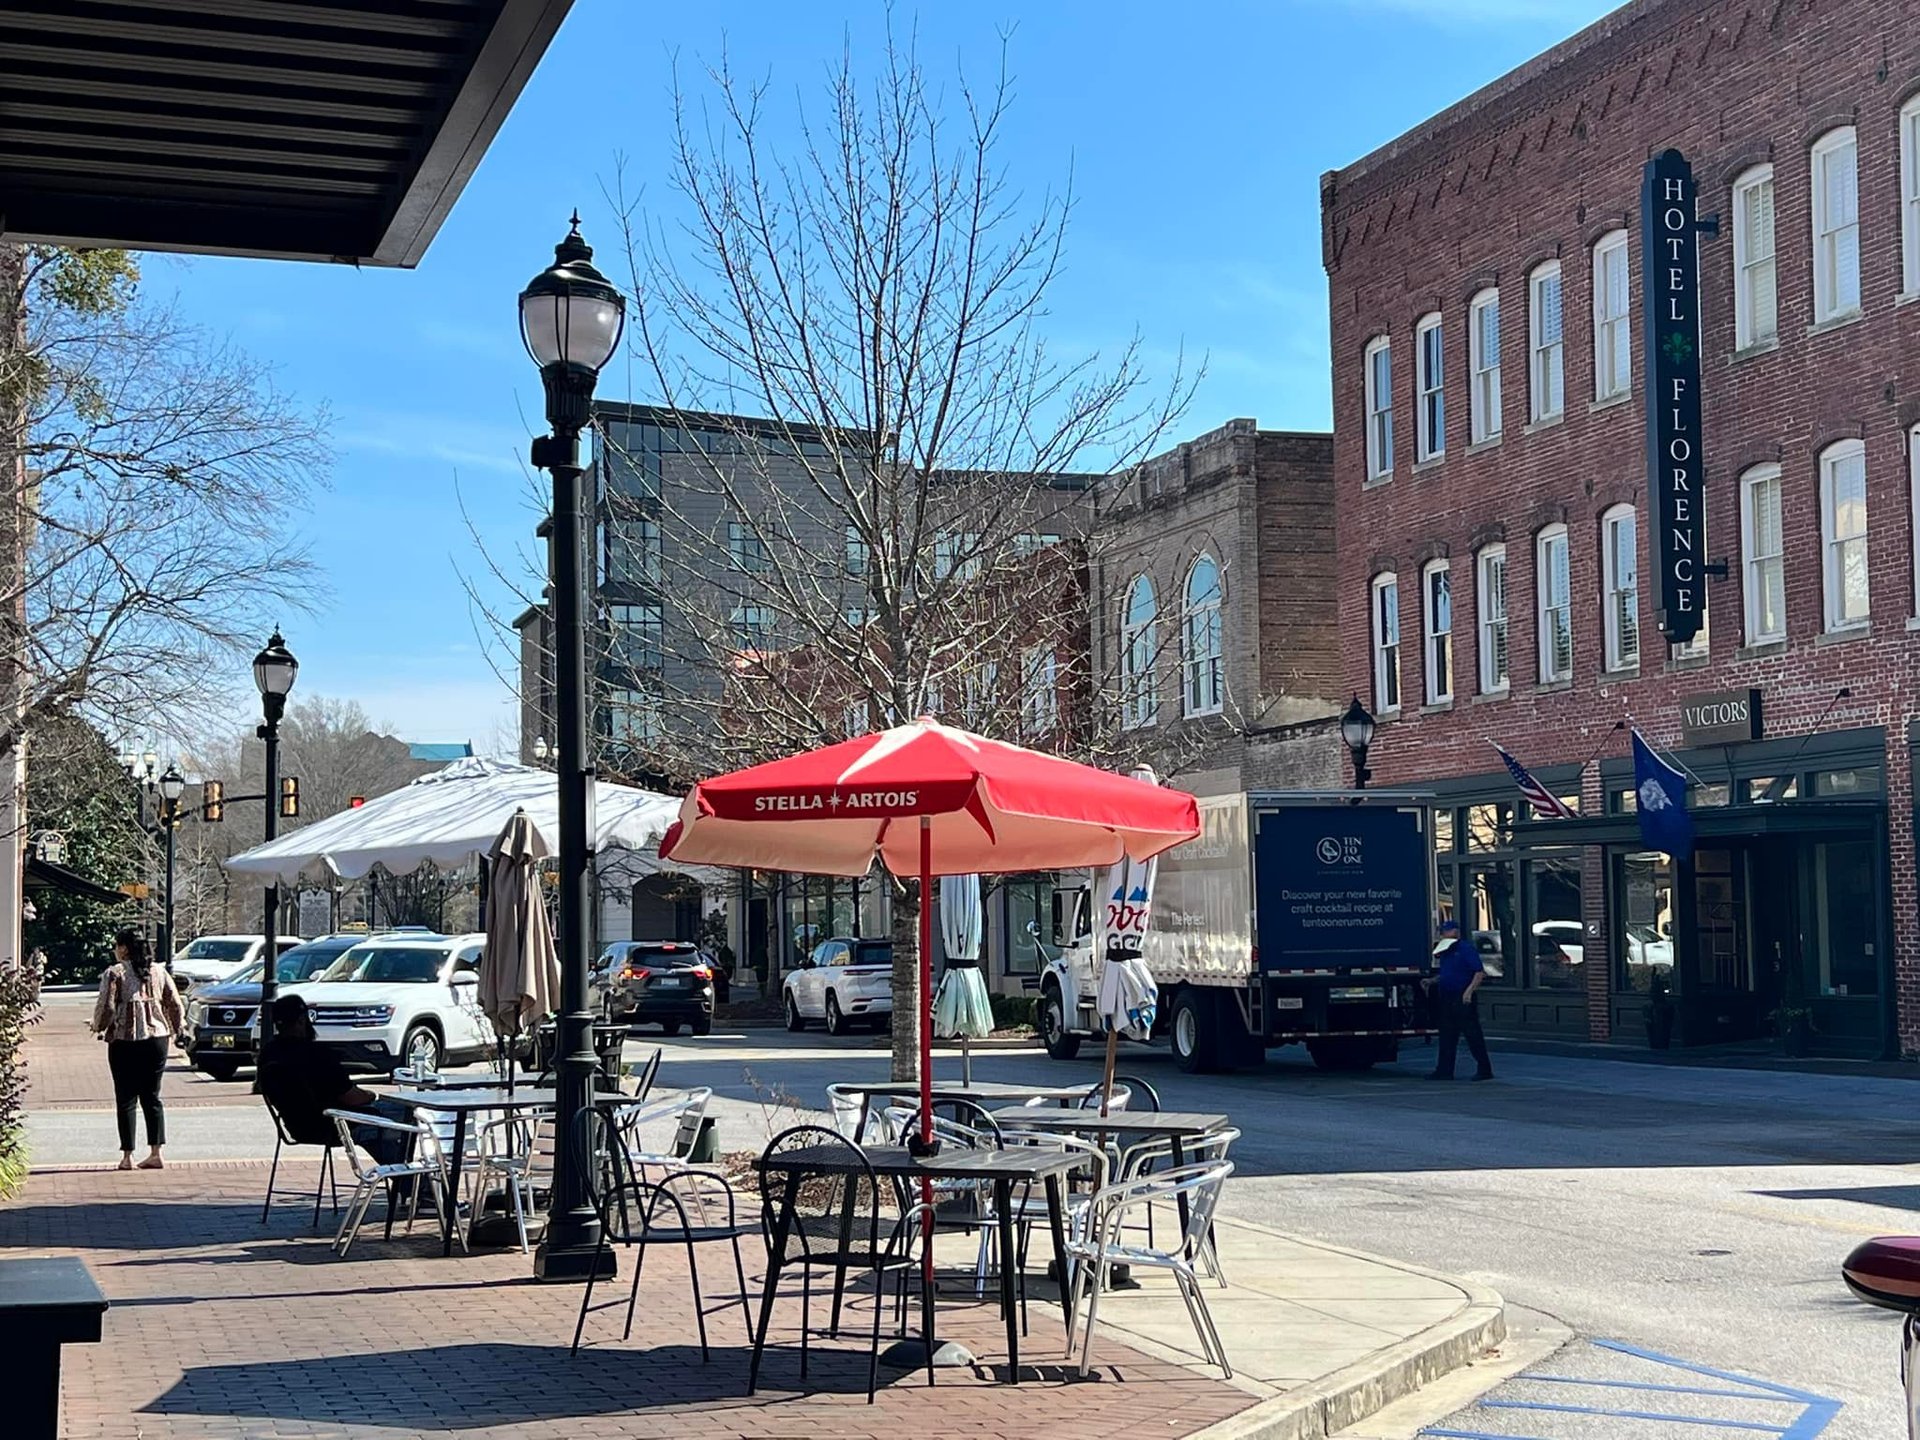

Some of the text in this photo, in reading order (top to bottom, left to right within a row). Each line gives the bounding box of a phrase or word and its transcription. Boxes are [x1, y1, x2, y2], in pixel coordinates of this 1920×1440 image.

[1664, 178, 1693, 613] HOTEL FLORENCE
[1685, 700, 1748, 726] VICTORS
[755, 790, 918, 811] STELLA ARTOIS
[1344, 846, 1358, 855] TO
[1343, 855, 1363, 864] ONE
[1282, 890, 1321, 900] Discover
[1324, 892, 1344, 901] your
[1368, 889, 1402, 899] favorite
[1291, 903, 1393, 914] craft cocktail recipe at
[1302, 918, 1383, 927] tentoonerum.com
